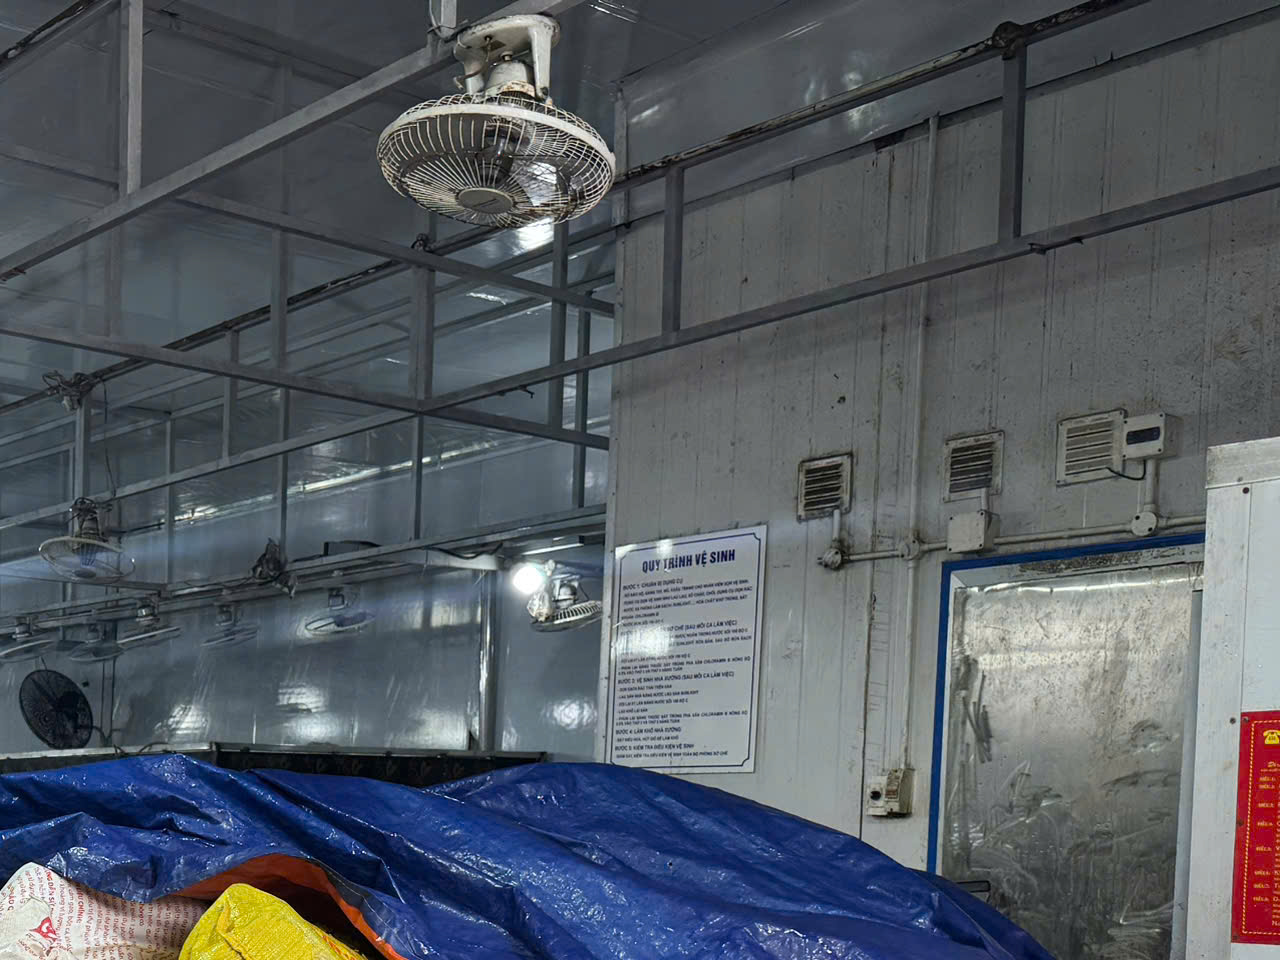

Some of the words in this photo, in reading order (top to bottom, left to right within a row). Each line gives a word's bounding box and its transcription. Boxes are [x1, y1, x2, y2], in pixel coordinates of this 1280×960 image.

[642, 559, 660, 574] QUY
[664, 554, 693, 570] TRÌNH
[695, 550, 707, 567] VỆ
[710, 549, 735, 563] SINH
